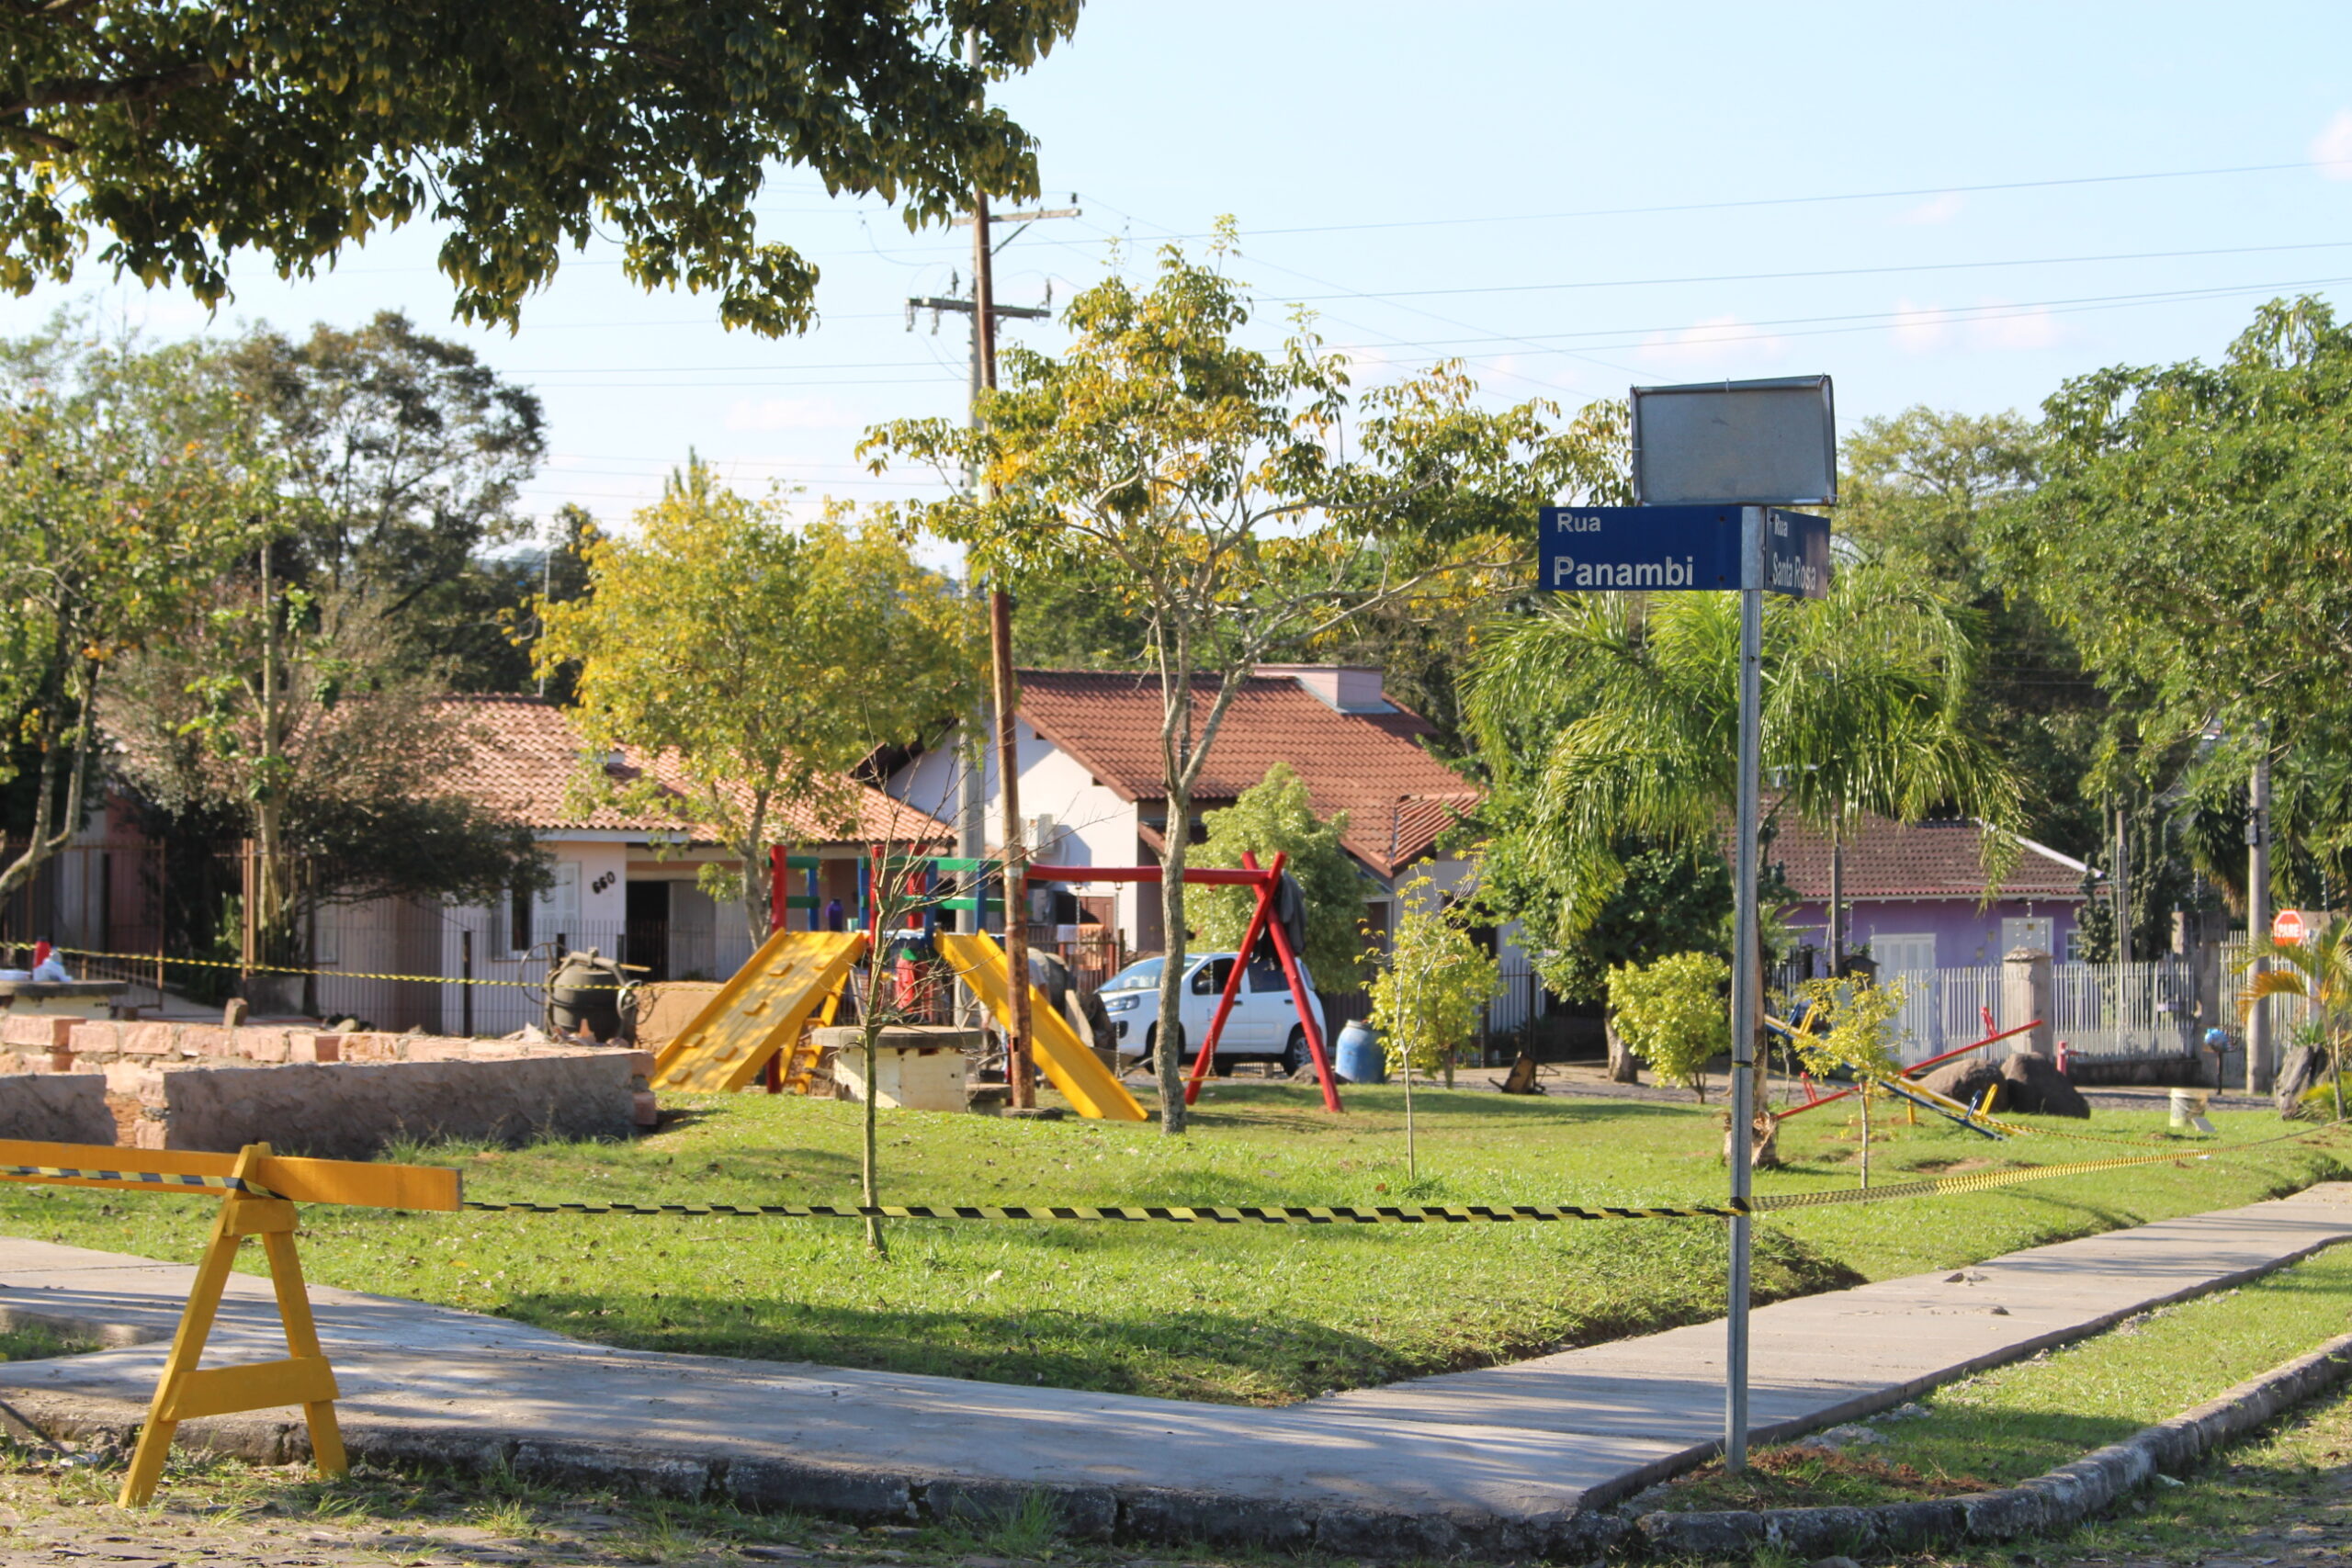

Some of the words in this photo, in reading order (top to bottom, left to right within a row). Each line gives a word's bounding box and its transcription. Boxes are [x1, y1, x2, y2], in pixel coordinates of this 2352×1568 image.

[1557, 512, 1601, 533] Rua
[1774, 513, 1788, 537] Rua
[1554, 555, 1693, 586] Panambi
[1772, 551, 1793, 588] Santa
[1793, 555, 1816, 591] Rosa
[592, 871, 616, 895] 660
[2277, 923, 2300, 938] PARE
